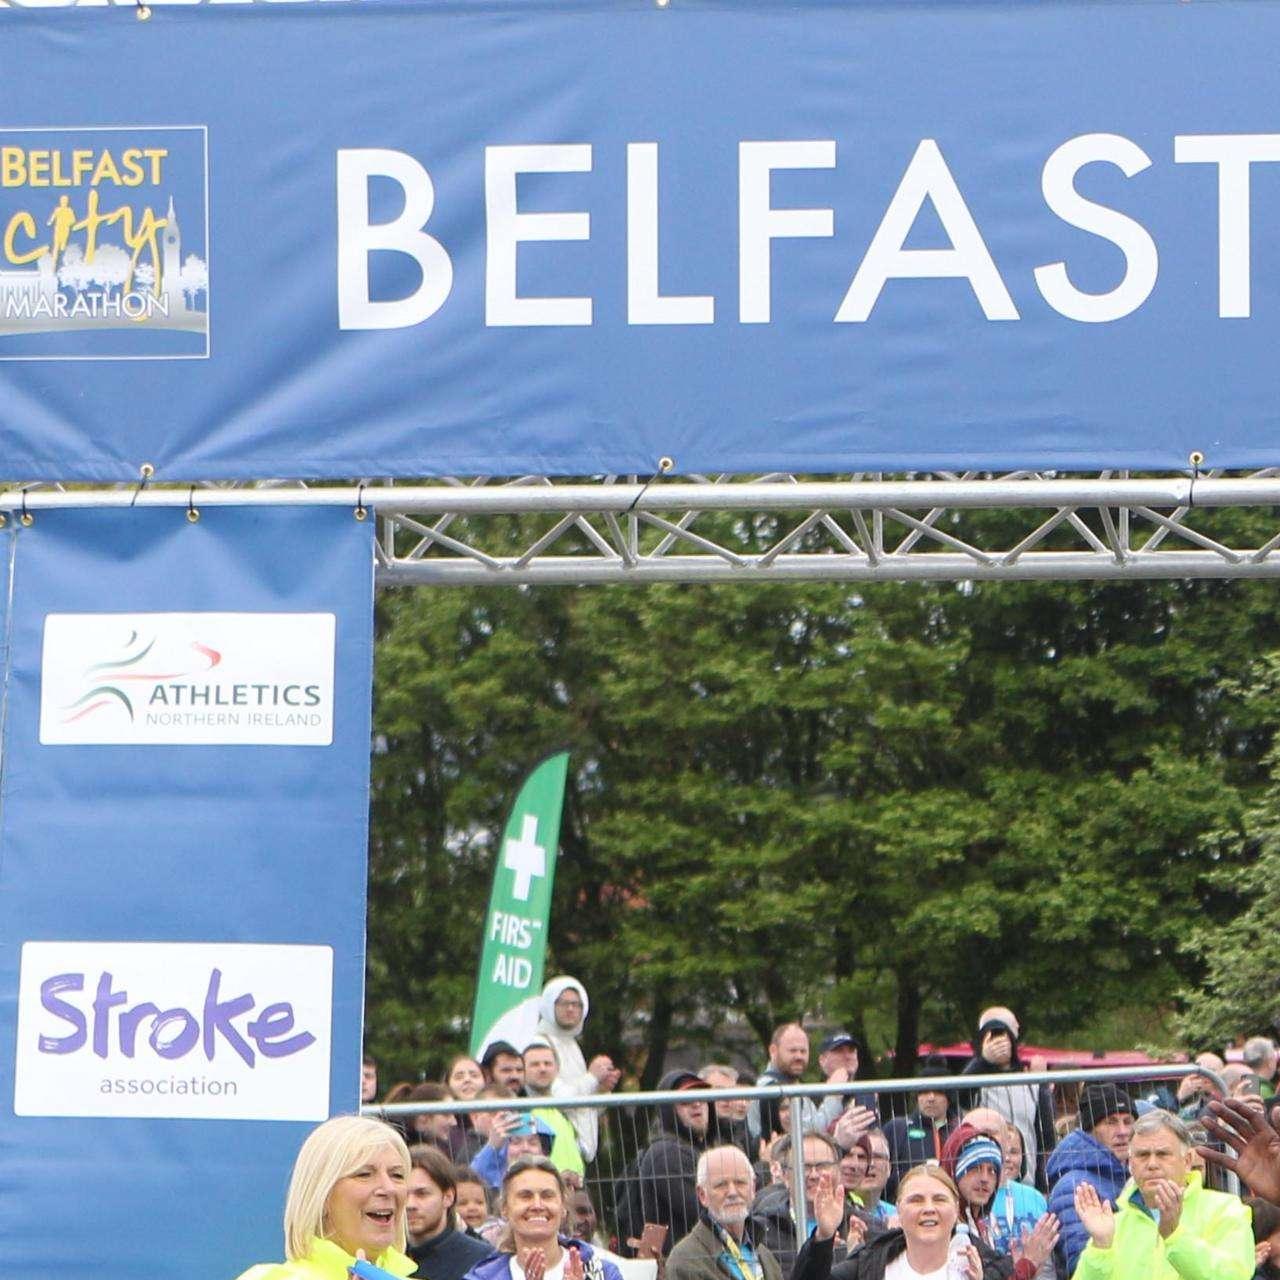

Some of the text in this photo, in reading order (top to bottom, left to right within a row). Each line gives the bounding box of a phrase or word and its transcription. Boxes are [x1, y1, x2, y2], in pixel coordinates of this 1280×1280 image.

[1, 147, 169, 187] BELFAST
[4, 189, 169, 321] city
[6, 292, 169, 319] MARATHON
[149, 684, 321, 707] ATHLETICS
[145, 712, 322, 727] NORTHERN IRELAND
[492, 953, 533, 989] AID
[37, 967, 318, 1069] Stroke
[99, 1074, 238, 1097] association
